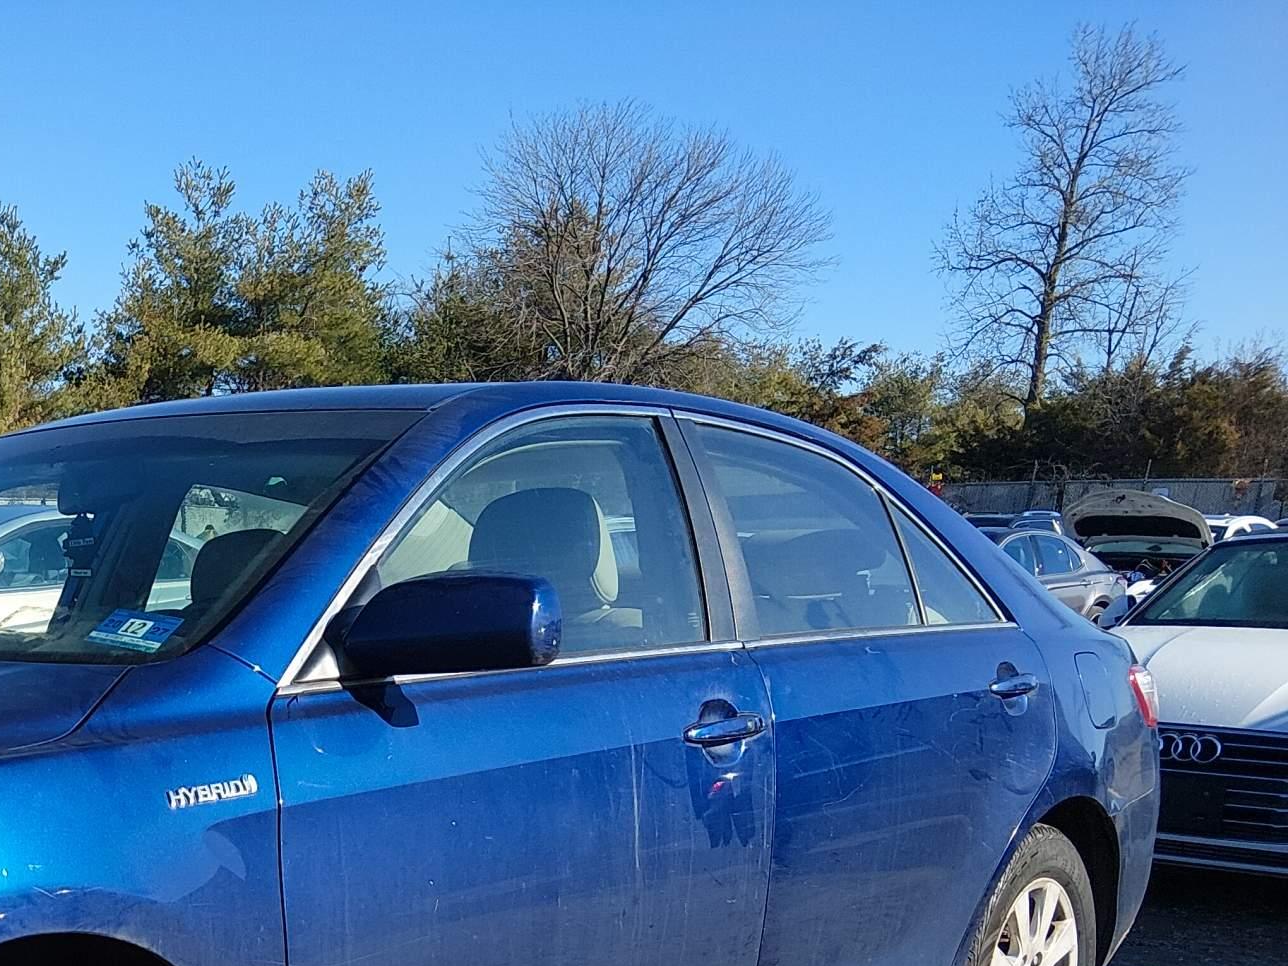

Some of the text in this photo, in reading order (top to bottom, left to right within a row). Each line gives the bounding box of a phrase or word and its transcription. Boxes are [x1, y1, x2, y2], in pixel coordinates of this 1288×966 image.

[120, 620, 148, 635] 12
[150, 625, 170, 636] 27
[166, 779, 247, 810] HYBRID
